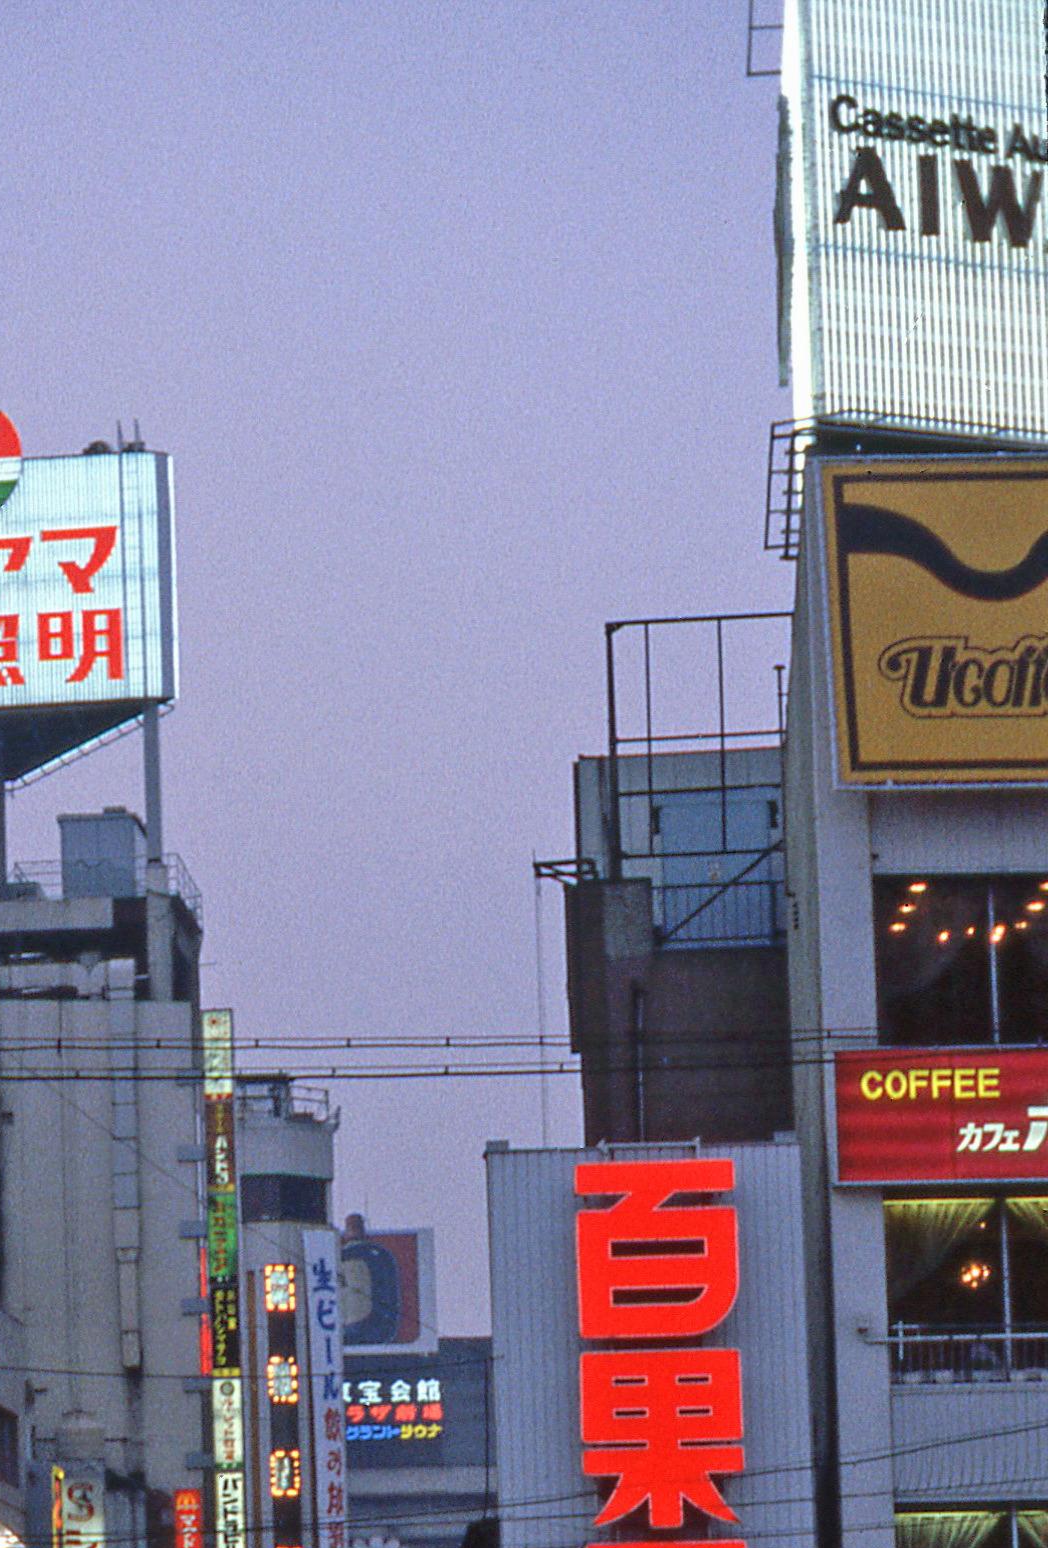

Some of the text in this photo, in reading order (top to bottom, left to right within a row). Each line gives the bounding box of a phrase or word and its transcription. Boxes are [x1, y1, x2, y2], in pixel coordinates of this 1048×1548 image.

[830, 94, 999, 155] Cassette
[886, 644, 1048, 709] Ucoff
[860, 1067, 1001, 1100] COFFEE
